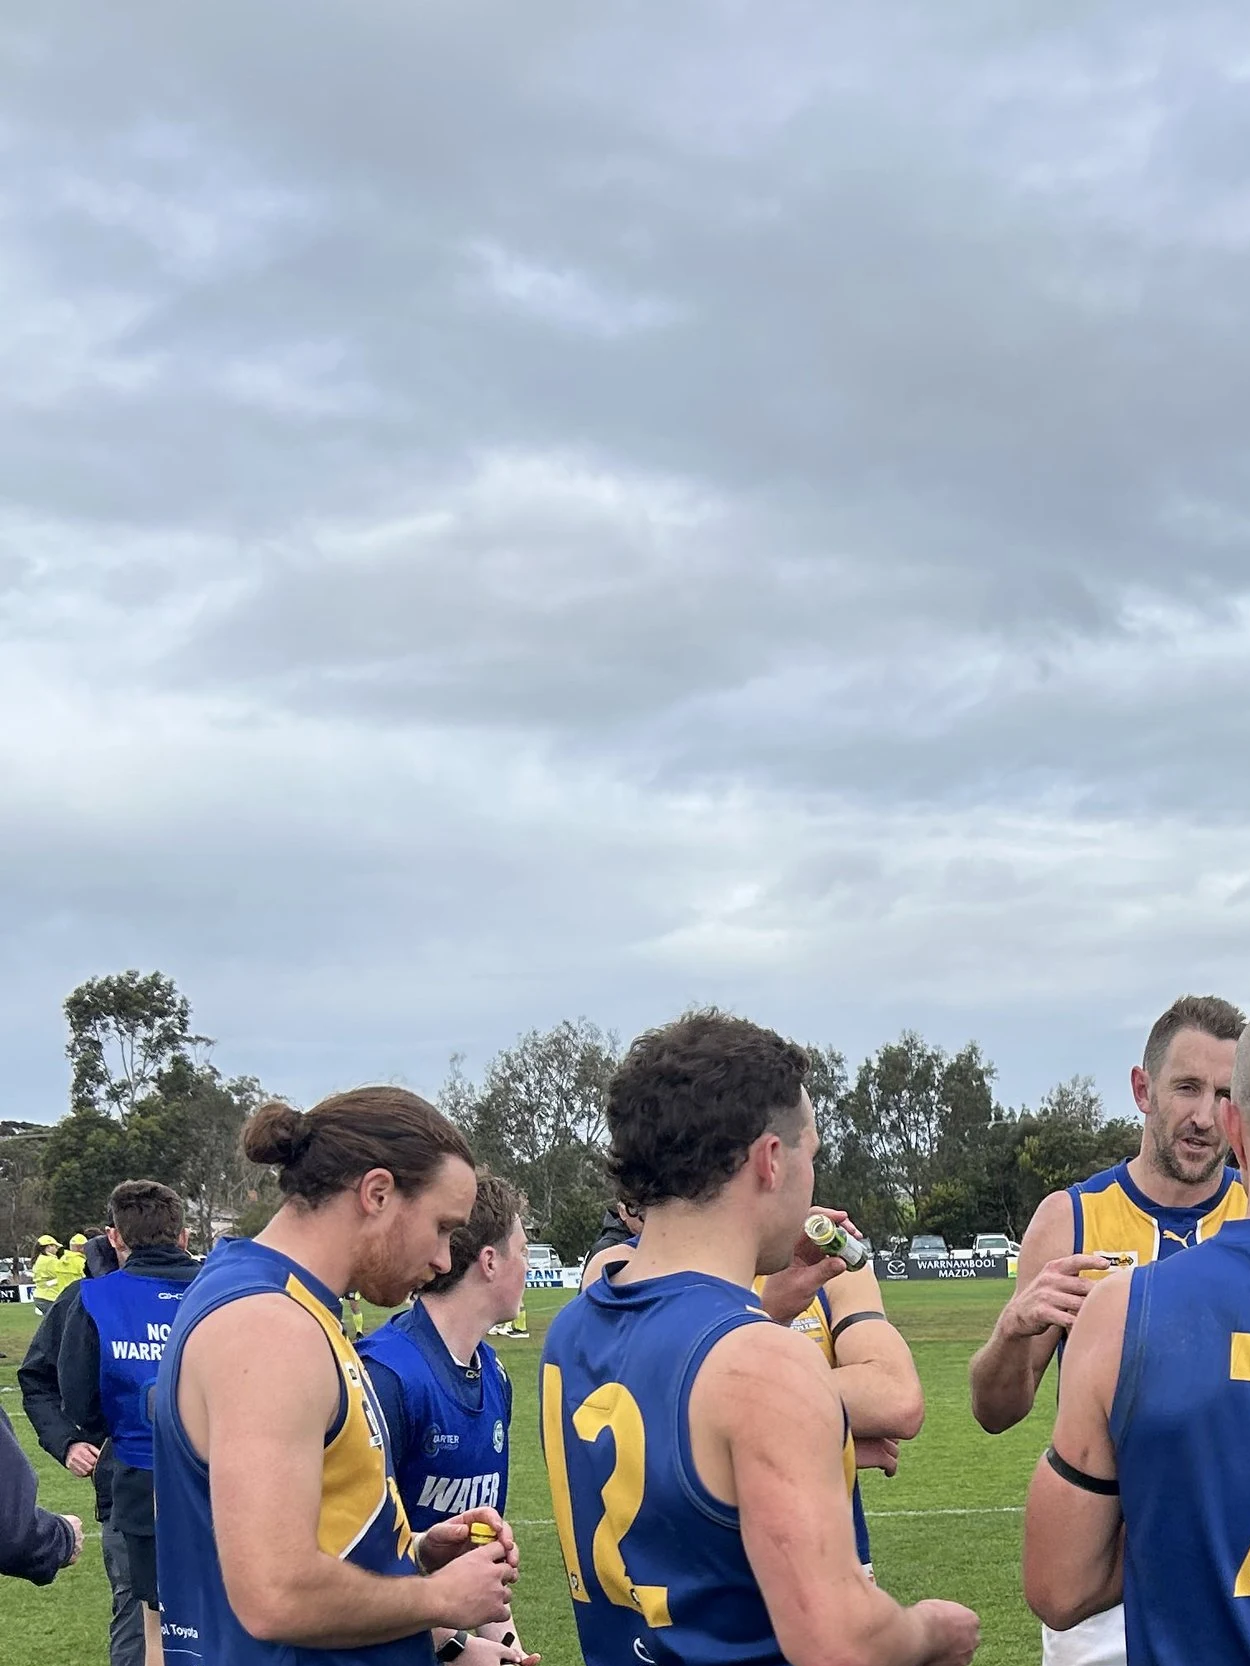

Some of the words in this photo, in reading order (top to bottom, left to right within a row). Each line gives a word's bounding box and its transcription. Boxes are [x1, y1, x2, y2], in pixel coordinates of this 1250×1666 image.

[917, 1259, 996, 1270] WARRNAMBOOL
[938, 1269, 977, 1279] MAZDA
[112, 1341, 166, 1360] WARR
[416, 1472, 500, 1513] WATER
[541, 1362, 673, 1628] 12
